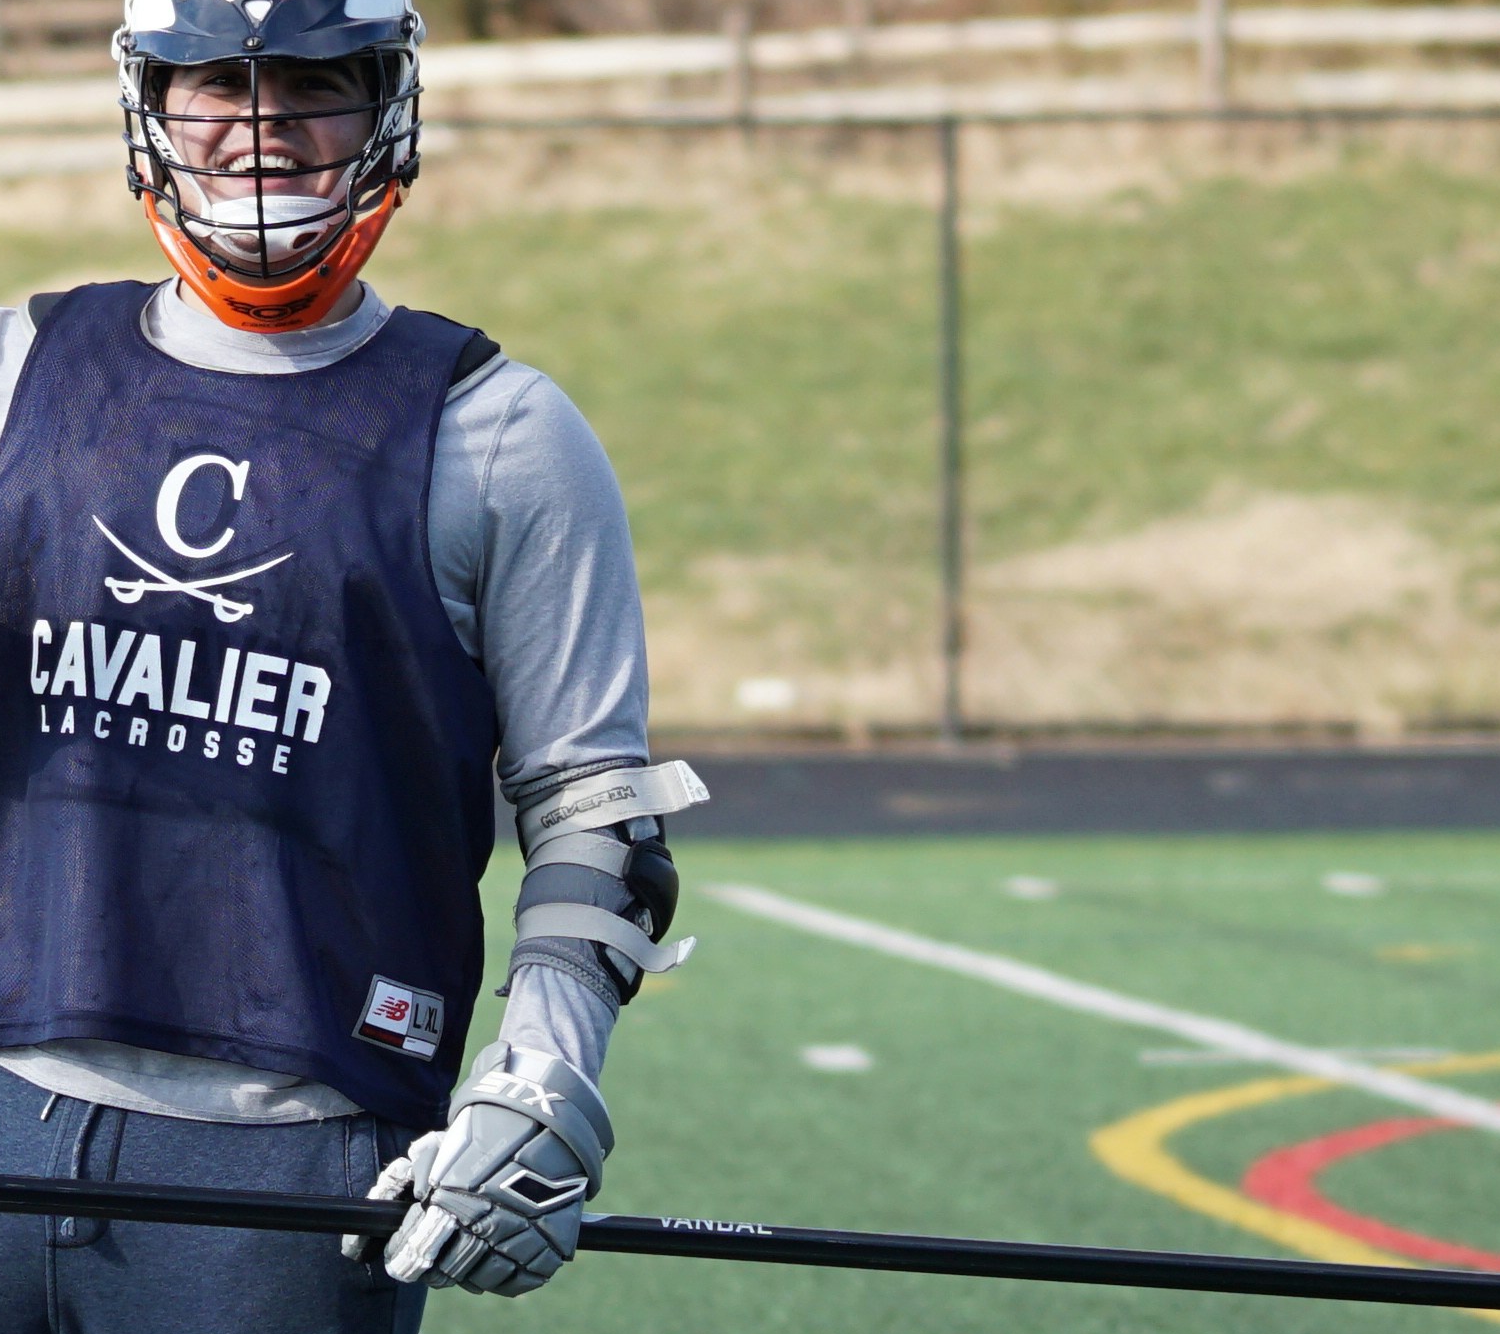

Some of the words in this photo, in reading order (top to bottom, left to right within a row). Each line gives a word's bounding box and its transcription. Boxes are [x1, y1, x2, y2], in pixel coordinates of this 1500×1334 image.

[156, 454, 250, 558] C
[30, 619, 332, 744] CAVALIER
[40, 704, 292, 775] LACROSSE
[540, 785, 637, 829] MAVERIK
[471, 1070, 567, 1117] STX
